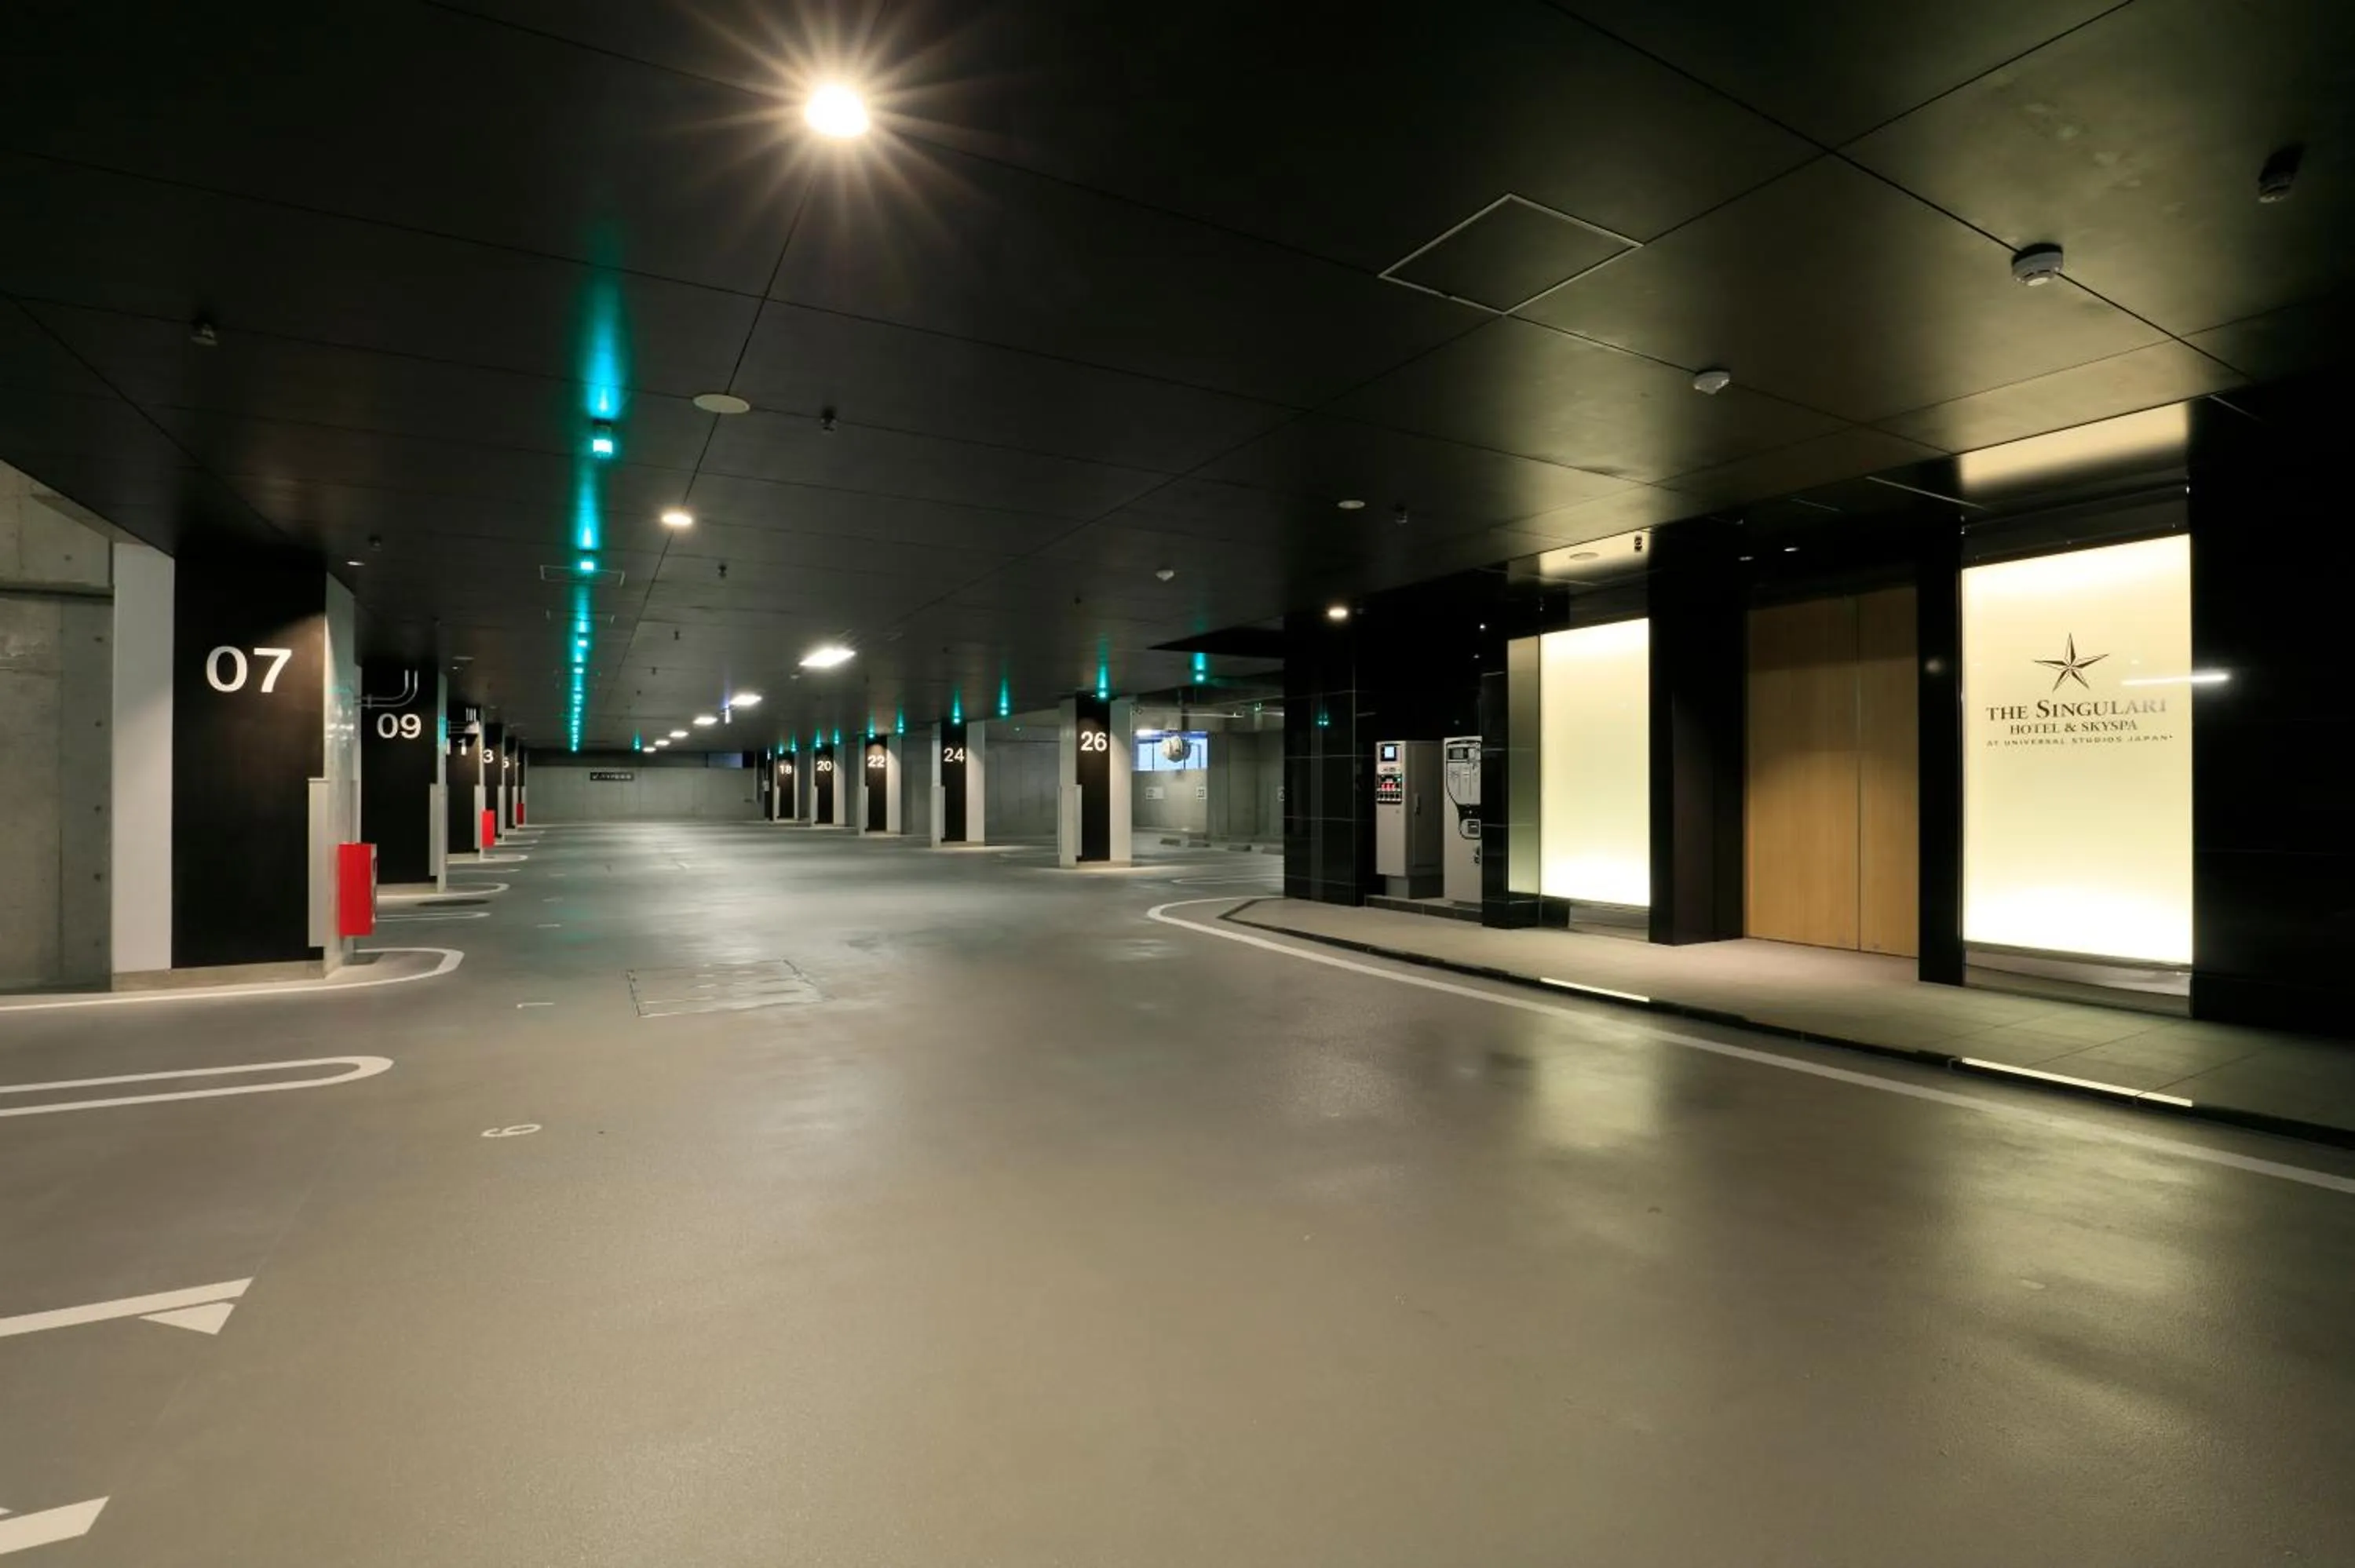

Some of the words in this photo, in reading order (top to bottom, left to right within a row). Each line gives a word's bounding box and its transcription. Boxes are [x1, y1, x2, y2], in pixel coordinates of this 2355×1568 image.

[206, 646, 292, 693] 07
[1986, 705, 2028, 721] THE
[2036, 698, 2167, 720] SINGULARI
[377, 713, 422, 738] 09
[2010, 722, 2060, 735] HOTEL
[2065, 722, 2077, 733] &
[2081, 720, 2138, 733] SKYSPA
[1080, 731, 1107, 751] 26
[2004, 738, 2065, 746] UNIVERSAL
[2072, 735, 2122, 745] STUDIOS
[867, 755, 885, 768] 22
[944, 747, 965, 762] 24
[816, 760, 832, 771] 20
